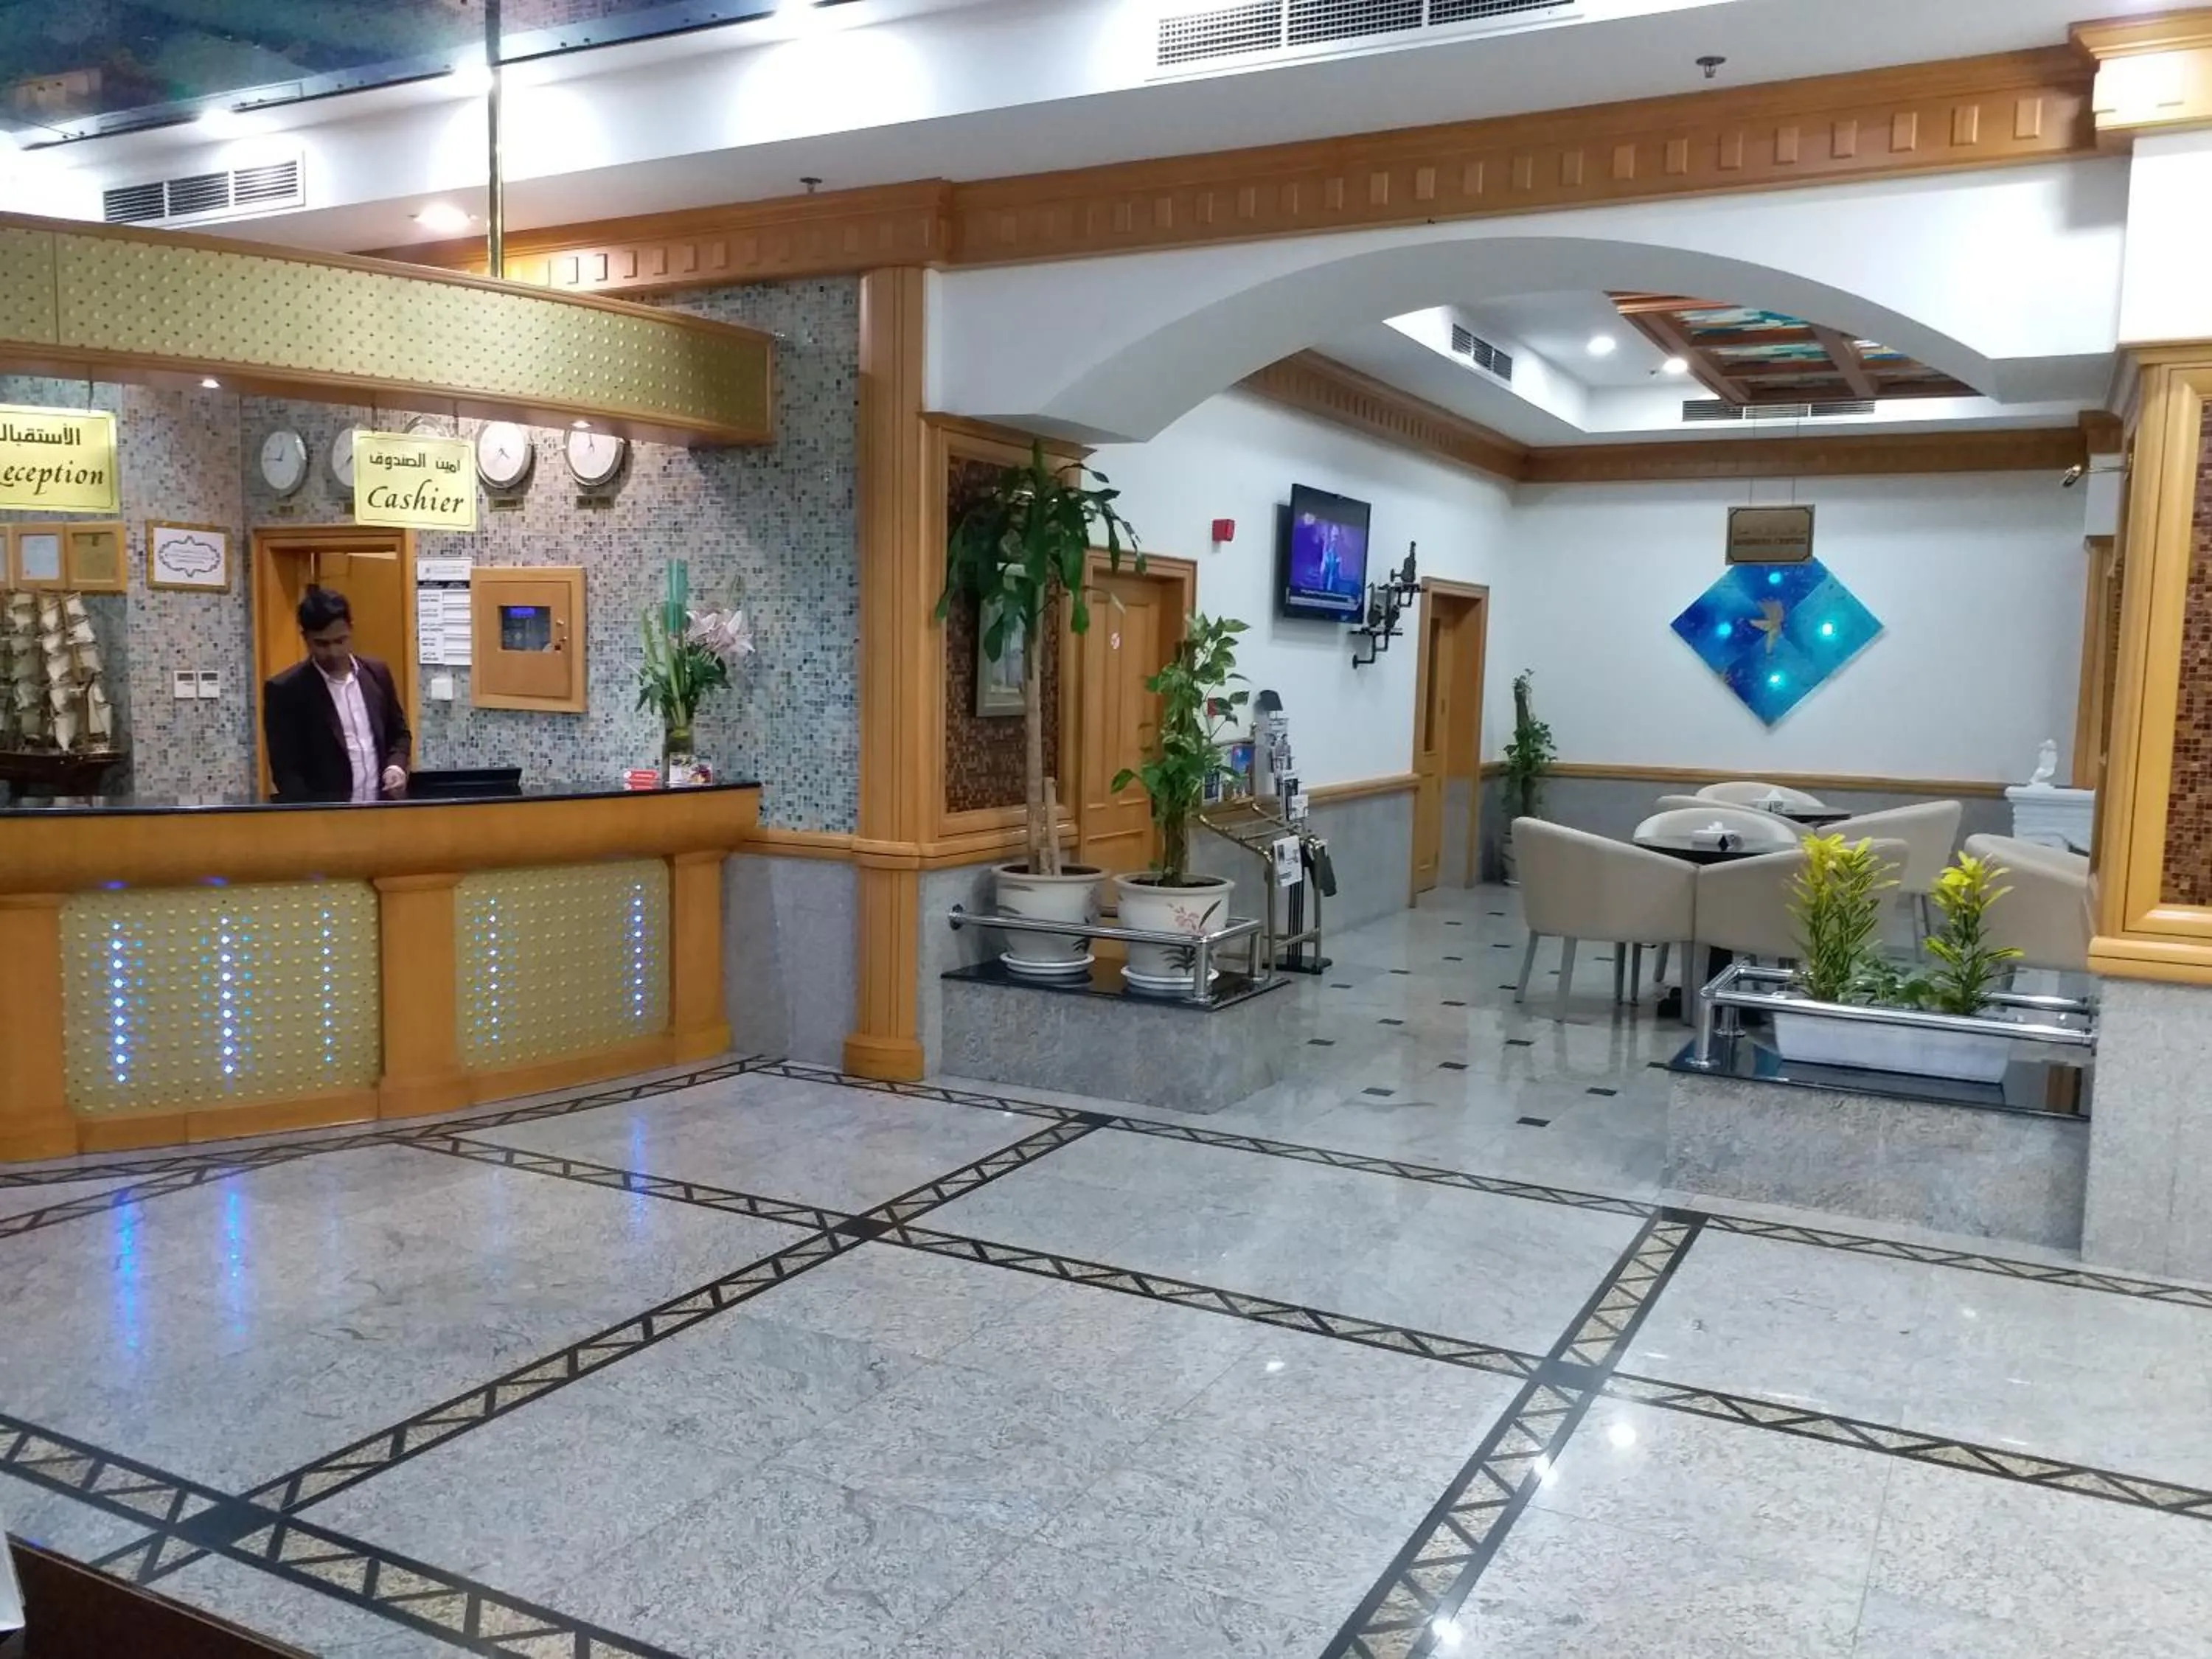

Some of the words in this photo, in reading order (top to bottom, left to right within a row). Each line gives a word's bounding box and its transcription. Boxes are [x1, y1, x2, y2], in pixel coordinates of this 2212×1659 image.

[0, 459, 104, 496] eception
[369, 452, 426, 470] الصندوق
[367, 479, 465, 513] Cashier
